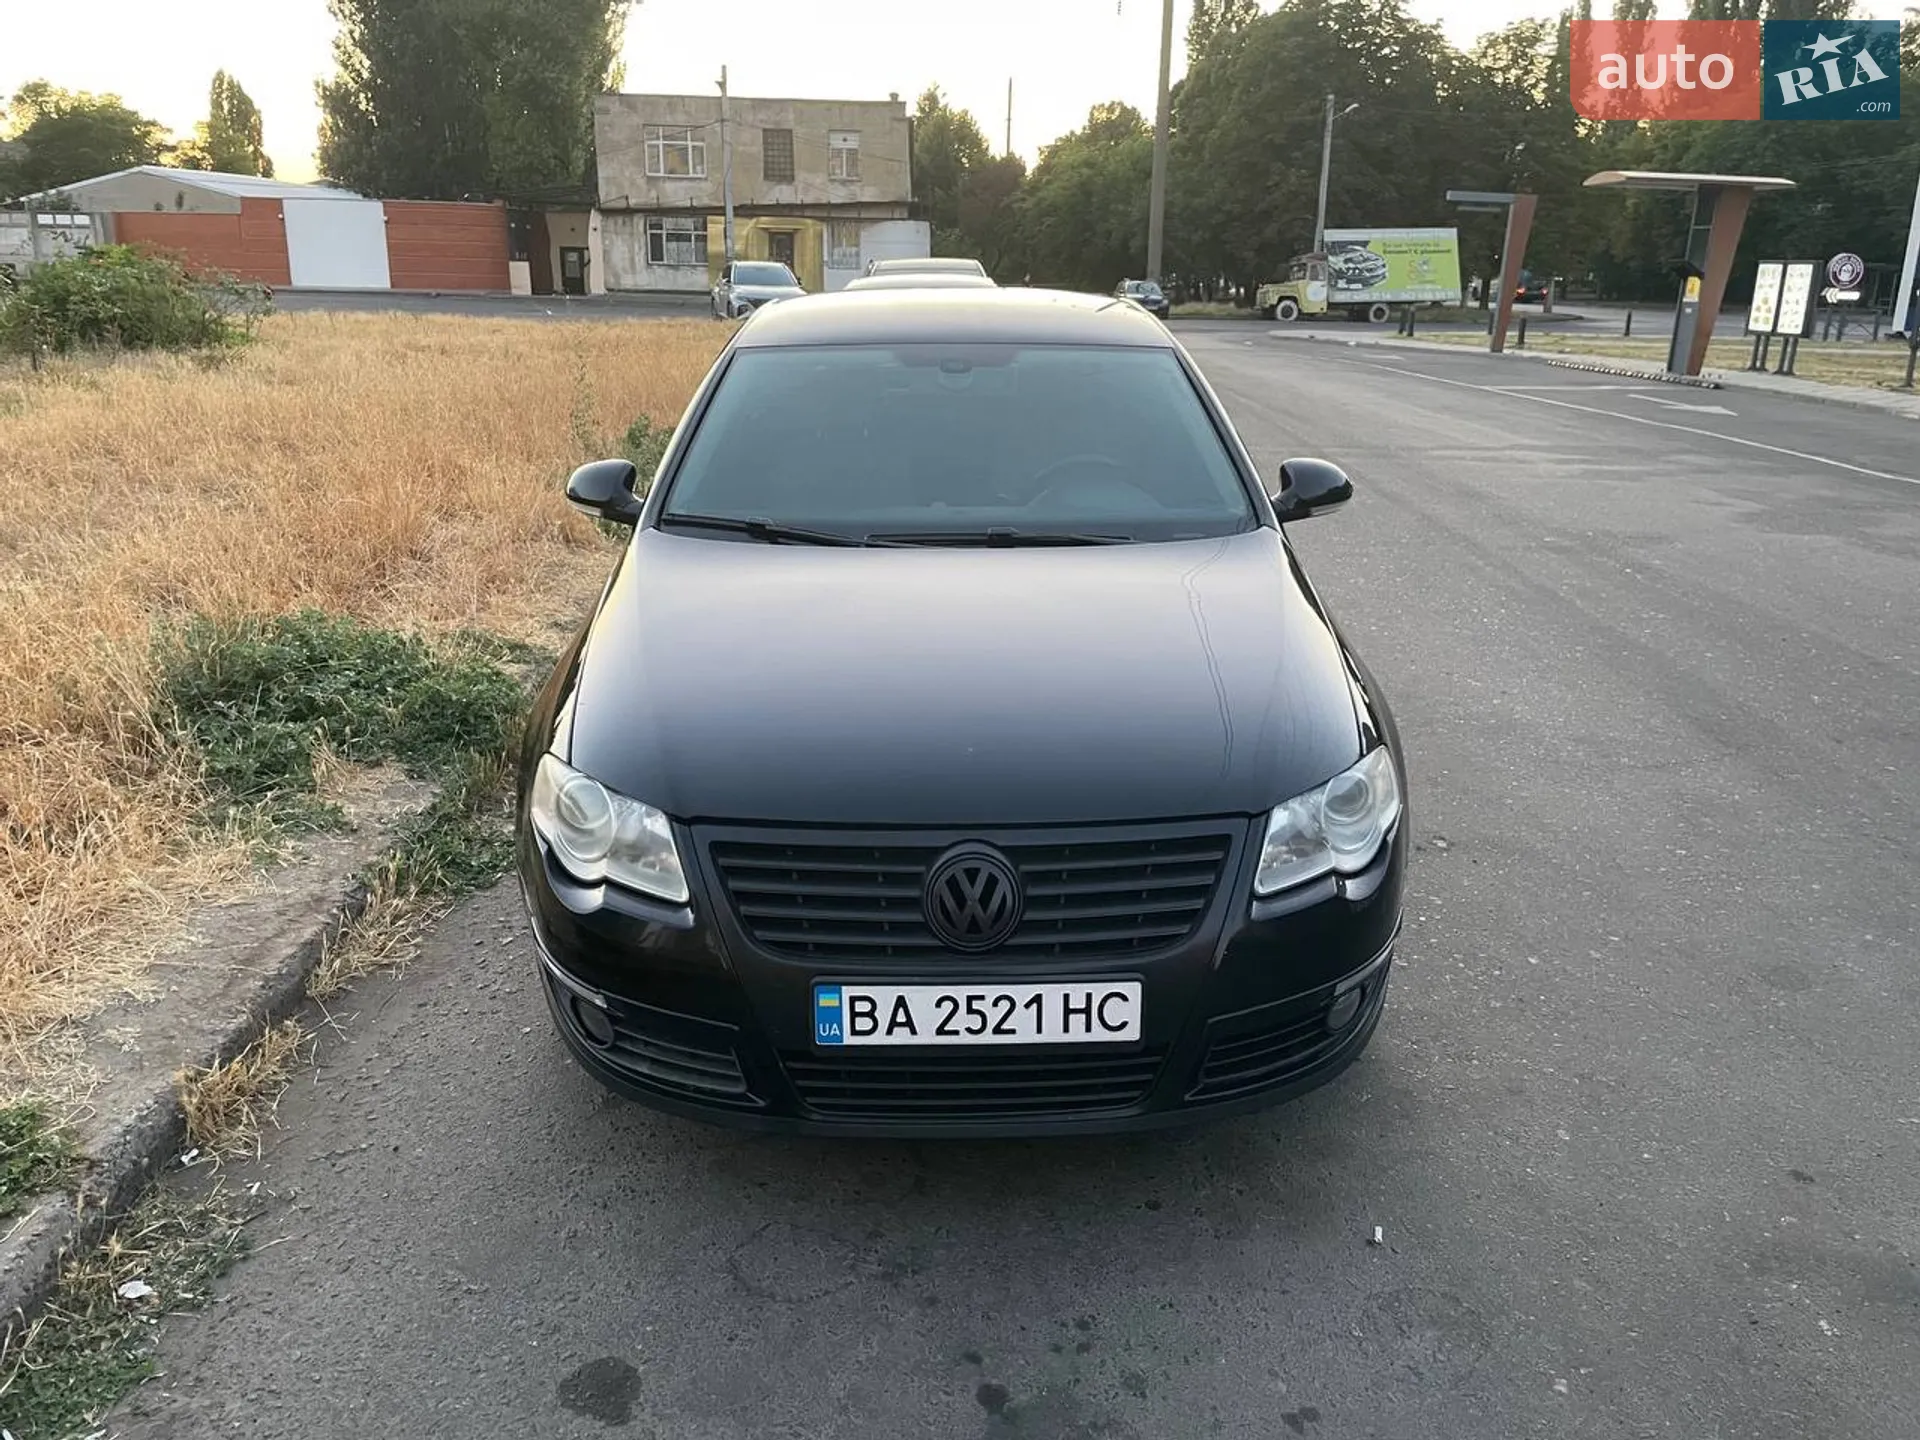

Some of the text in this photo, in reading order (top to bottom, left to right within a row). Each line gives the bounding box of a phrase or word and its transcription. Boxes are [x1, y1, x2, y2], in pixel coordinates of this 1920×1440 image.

[848, 991, 1130, 1037] BA 2521 HC
[819, 1023, 841, 1037] UA
